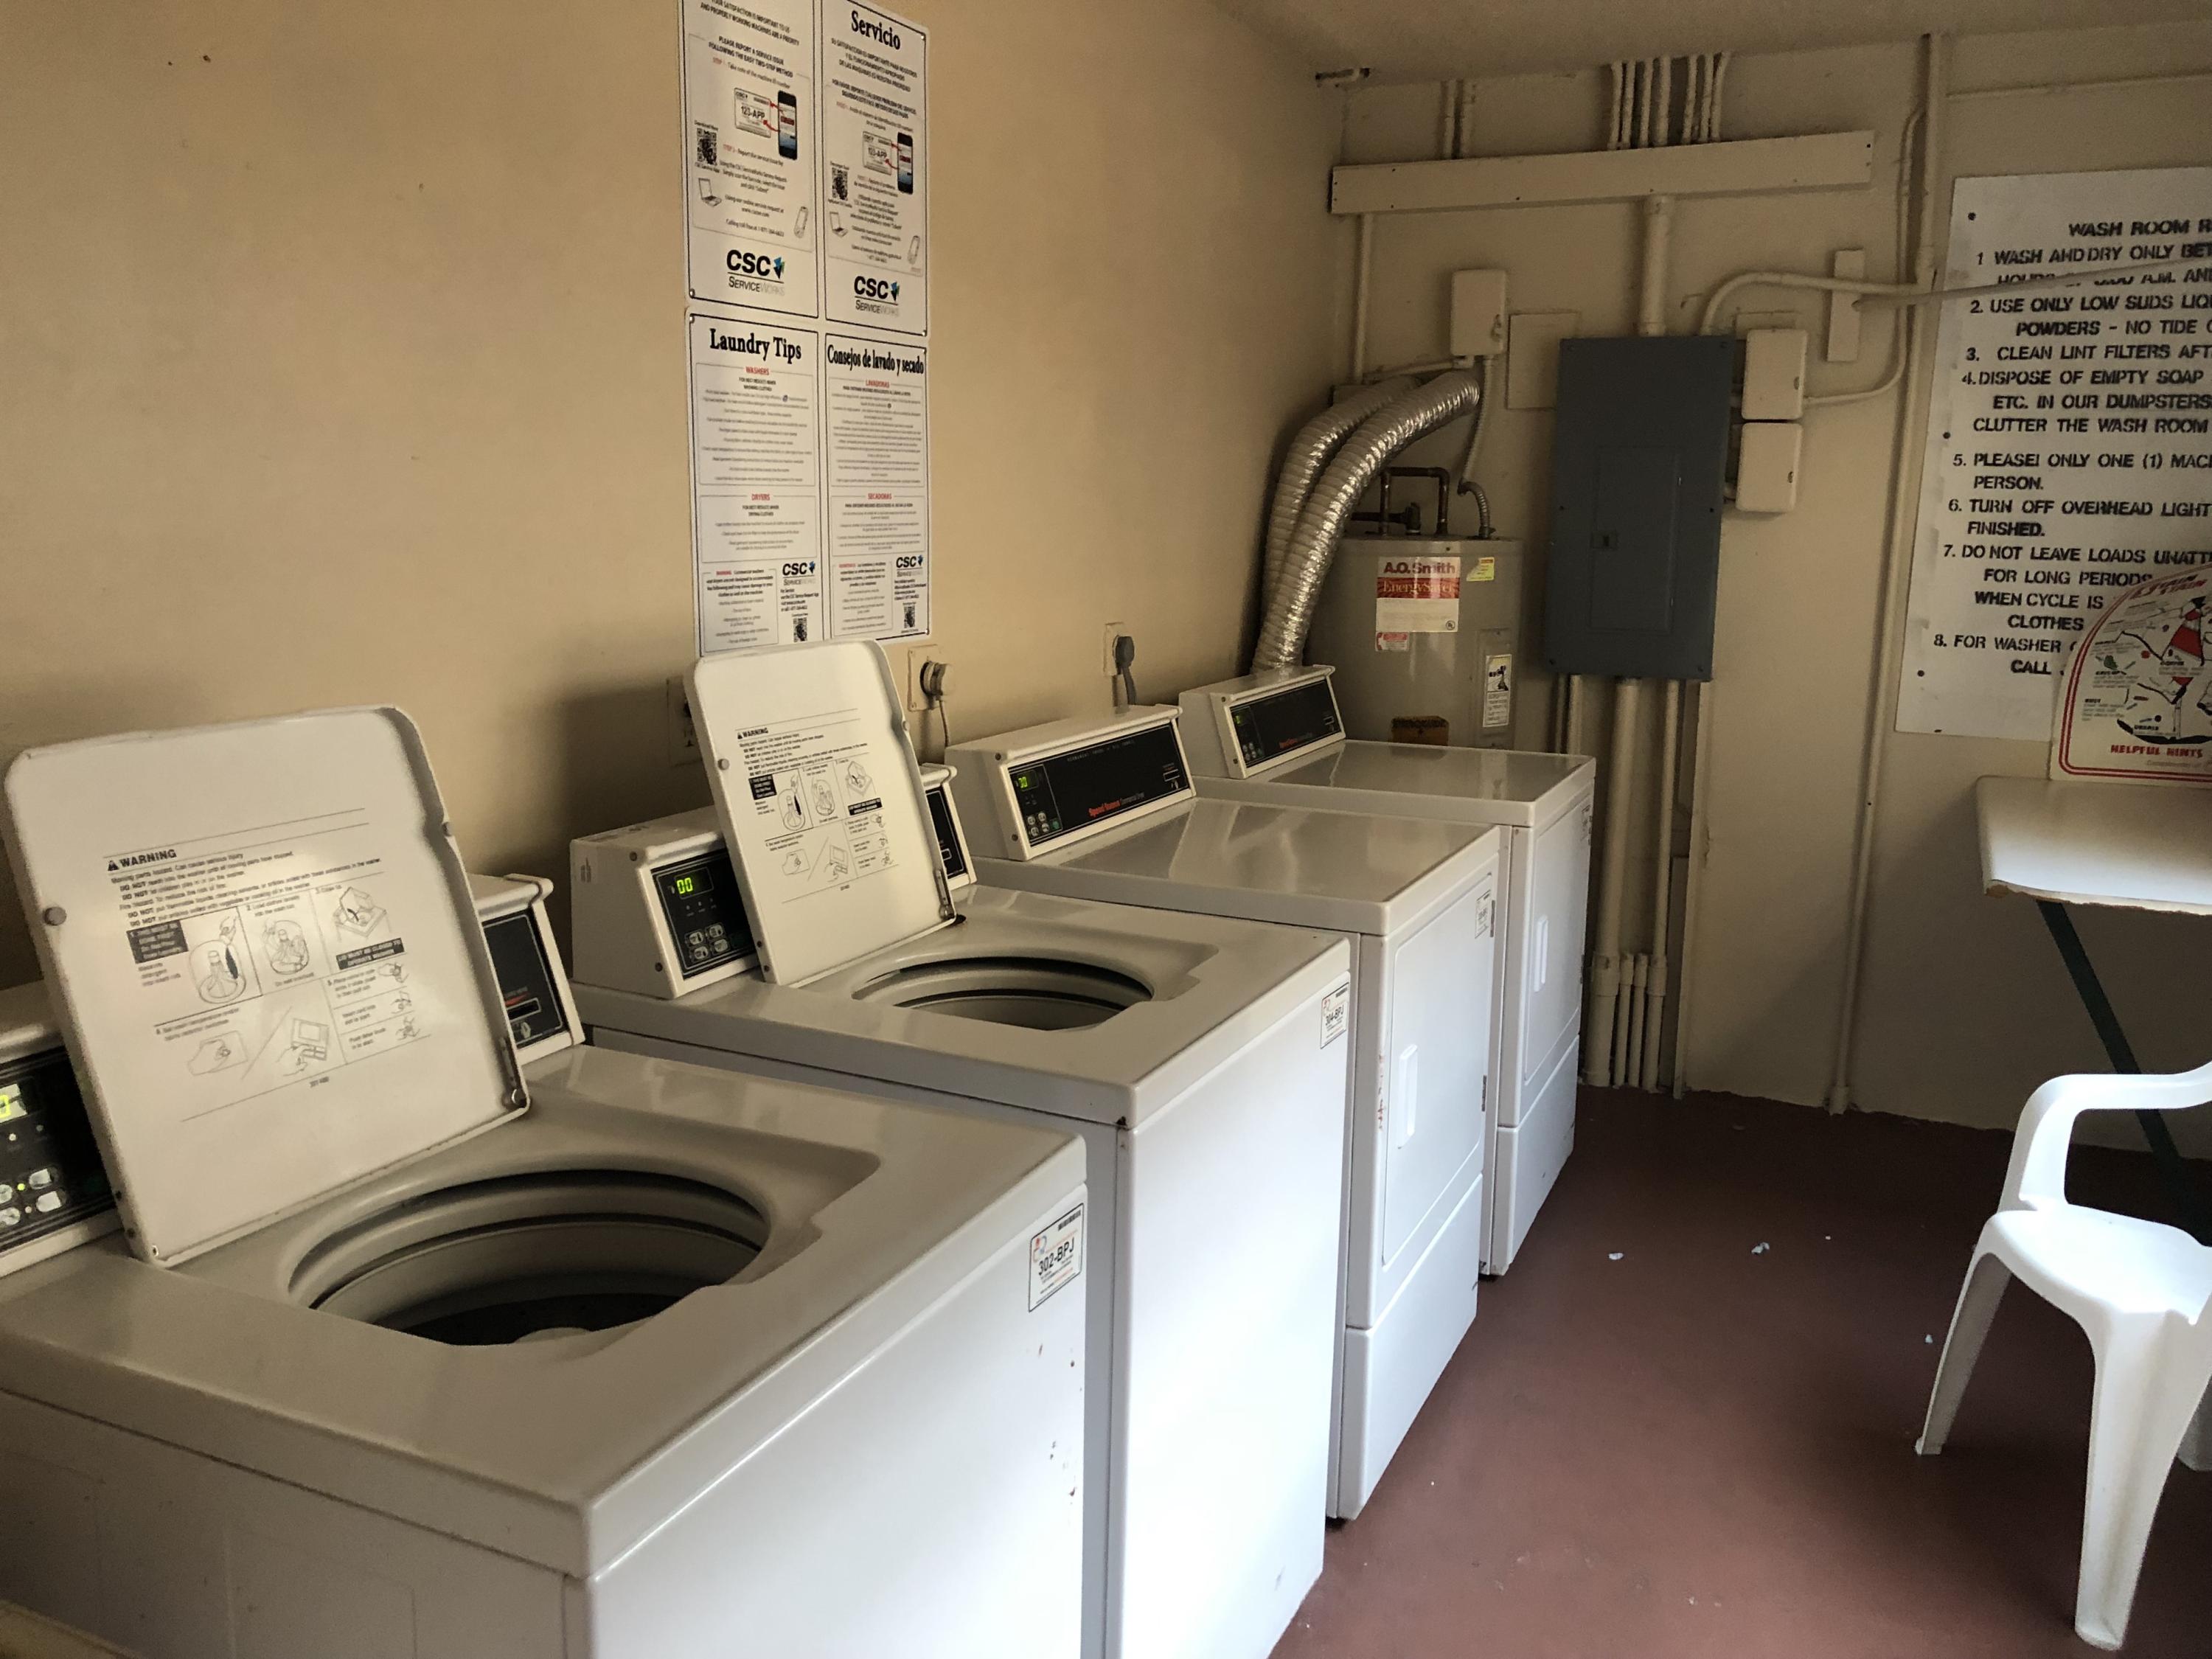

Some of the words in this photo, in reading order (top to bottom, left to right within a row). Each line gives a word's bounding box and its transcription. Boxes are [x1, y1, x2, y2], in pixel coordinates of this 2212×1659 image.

[852, 10, 900, 49] Servicio
[2069, 222, 2122, 237] WASH
[2131, 220, 2188, 235] ROOM
[726, 249, 771, 276] CSC
[1994, 249, 2042, 264] WASH
[2049, 248, 2084, 262] AND
[2088, 246, 2123, 261] DRY
[2130, 245, 2174, 260] ONLY
[854, 276, 888, 299] CSC
[1970, 300, 1983, 313] 2.
[1991, 298, 2025, 313] USE
[2031, 296, 2073, 312] ONLY
[2080, 296, 2119, 310] LOW
[2125, 294, 2173, 310] SUDS
[2181, 294, 2212, 309] LIQ
[2016, 321, 2101, 336] POWDERS
[2125, 319, 2152, 335] NO
[2160, 319, 2198, 334] TIDE
[709, 328, 770, 361] Laundry
[773, 336, 801, 364] Tips
[1966, 347, 1980, 361] 3.
[1997, 346, 2053, 361] CLEAN
[2061, 345, 2097, 360] LINT
[2104, 344, 2170, 359] FILTERS
[827, 344, 861, 371] Consejos
[863, 349, 871, 368] de
[872, 349, 895, 371] lavado
[897, 358, 900, 377] y
[902, 355, 924, 374] secado
[1961, 372, 1977, 385] 4.
[1979, 370, 2051, 385] DISPOSE
[2059, 370, 2084, 385] OF
[2090, 369, 2149, 385] EMPTY
[2157, 369, 2204, 384] SOAP
[1993, 394, 2028, 409] ETC.
[2037, 394, 2054, 409] IN
[2062, 394, 2098, 409] OUR
[1973, 417, 2048, 433] CLUTTER
[2057, 418, 2090, 433] THE
[2098, 418, 2148, 434] WASH
[2154, 418, 2208, 434] ROOM
[1952, 453, 1967, 467] 5.
[2048, 453, 2090, 468] ONLY
[2098, 453, 2135, 468] ONE
[2142, 453, 2163, 470] (1)
[1973, 476, 2044, 490] PERSON.
[1948, 499, 1962, 512] 6.
[1969, 499, 2012, 513] TURN
[2022, 500, 2055, 514] OFF
[2062, 501, 2153, 515] OVERHEAD
[1967, 521, 2045, 537] FINISHED.
[896, 556, 917, 568] CSC
[1944, 544, 1955, 557] 7.
[1961, 545, 1986, 558] DO
[1989, 546, 2023, 560] NOT
[2030, 546, 2081, 562] LEAVE
[2088, 549, 2146, 564] LOADS
[2154, 550, 2212, 565] UNATT
[782, 563, 807, 576] CSC
[1413, 563, 1455, 574] Smith
[1983, 568, 2017, 582] FOR
[2025, 570, 2070, 585] LONG
[1975, 591, 2022, 606] WHEN
[2026, 593, 2079, 608] CYCLE
[2087, 594, 2104, 610] IS
[2007, 614, 2084, 631] CLOTHES
[1933, 634, 1947, 647] 8.
[1954, 635, 1986, 649] FOR
[1994, 637, 2062, 653] WASHER
[2011, 659, 2052, 675] CALL
[742, 727, 768, 738] WARNING
[2110, 745, 2160, 755] HELPFUL
[2166, 747, 2203, 759] HINTS
[119, 849, 177, 867] WARNING
[677, 877, 694, 894] 00
[1038, 1237, 1074, 1276] 302-BPJ
